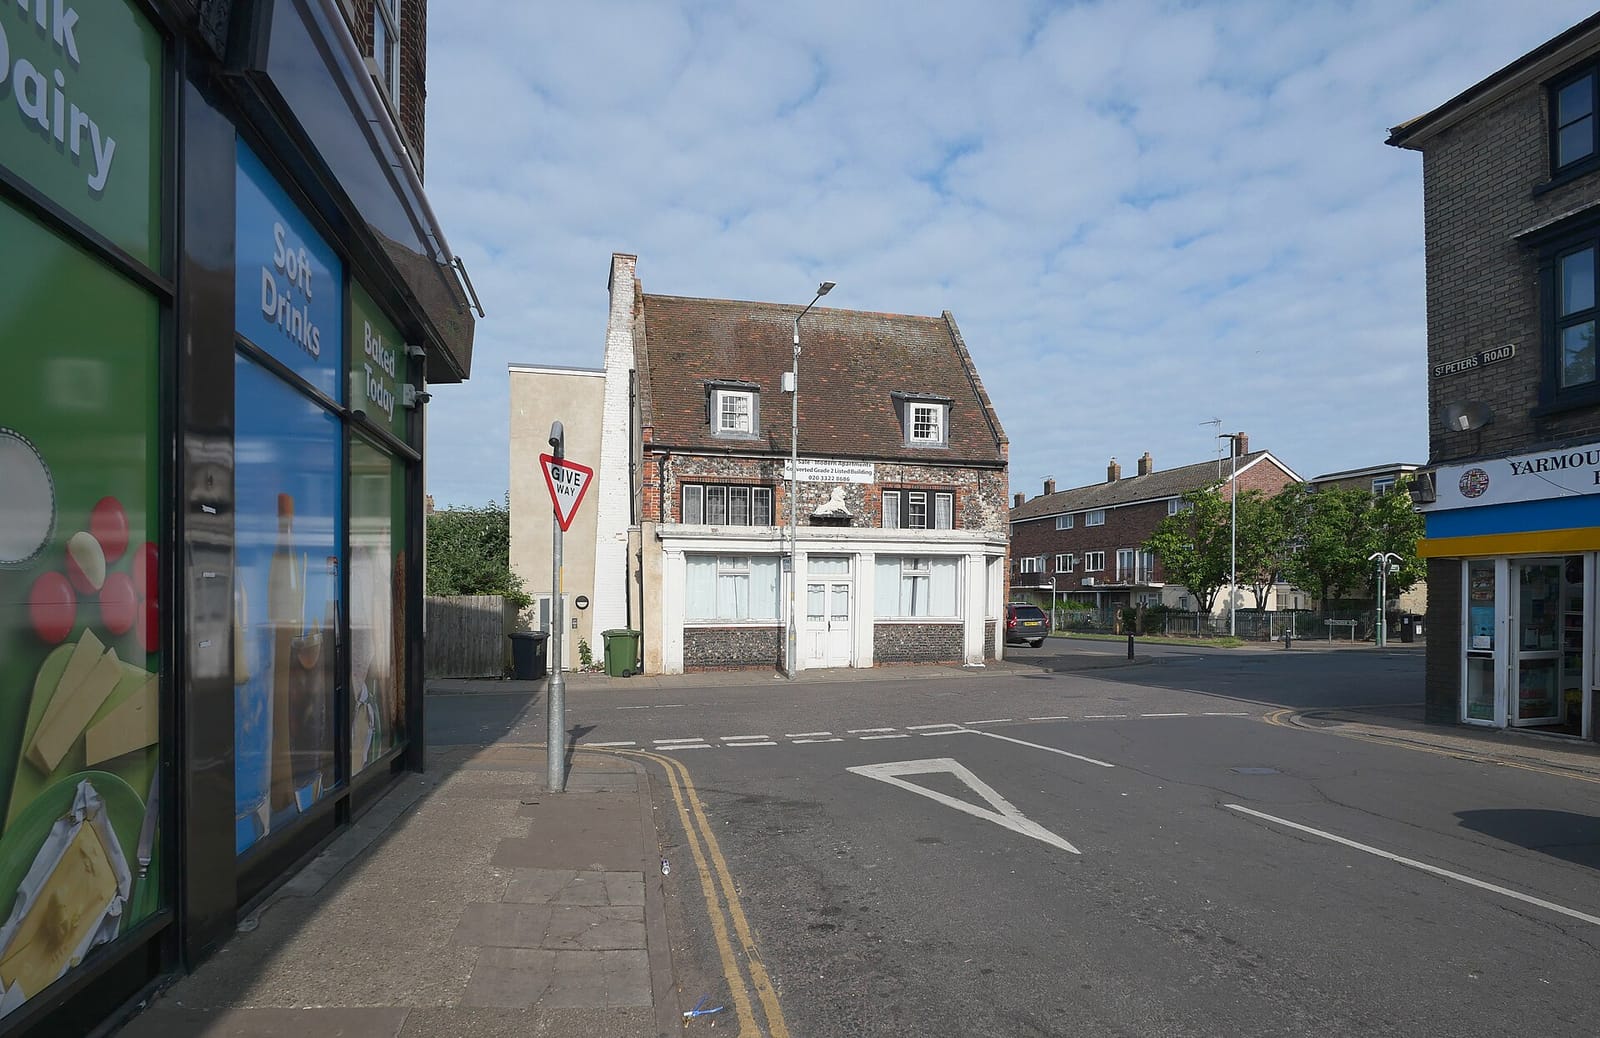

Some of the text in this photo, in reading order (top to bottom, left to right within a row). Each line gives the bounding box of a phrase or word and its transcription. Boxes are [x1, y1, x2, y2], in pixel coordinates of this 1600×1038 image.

[0, 20, 116, 191] airy
[273, 222, 312, 299] Soft
[262, 266, 320, 356] Drinks
[364, 321, 395, 378] Baked
[1445, 356, 1478, 374] PETERS
[1483, 347, 1510, 363] ROAD
[364, 363, 395, 421] Today
[551, 466, 581, 486] GIVE
[556, 483, 576, 497] WAY
[851, 469, 872, 477] Building
